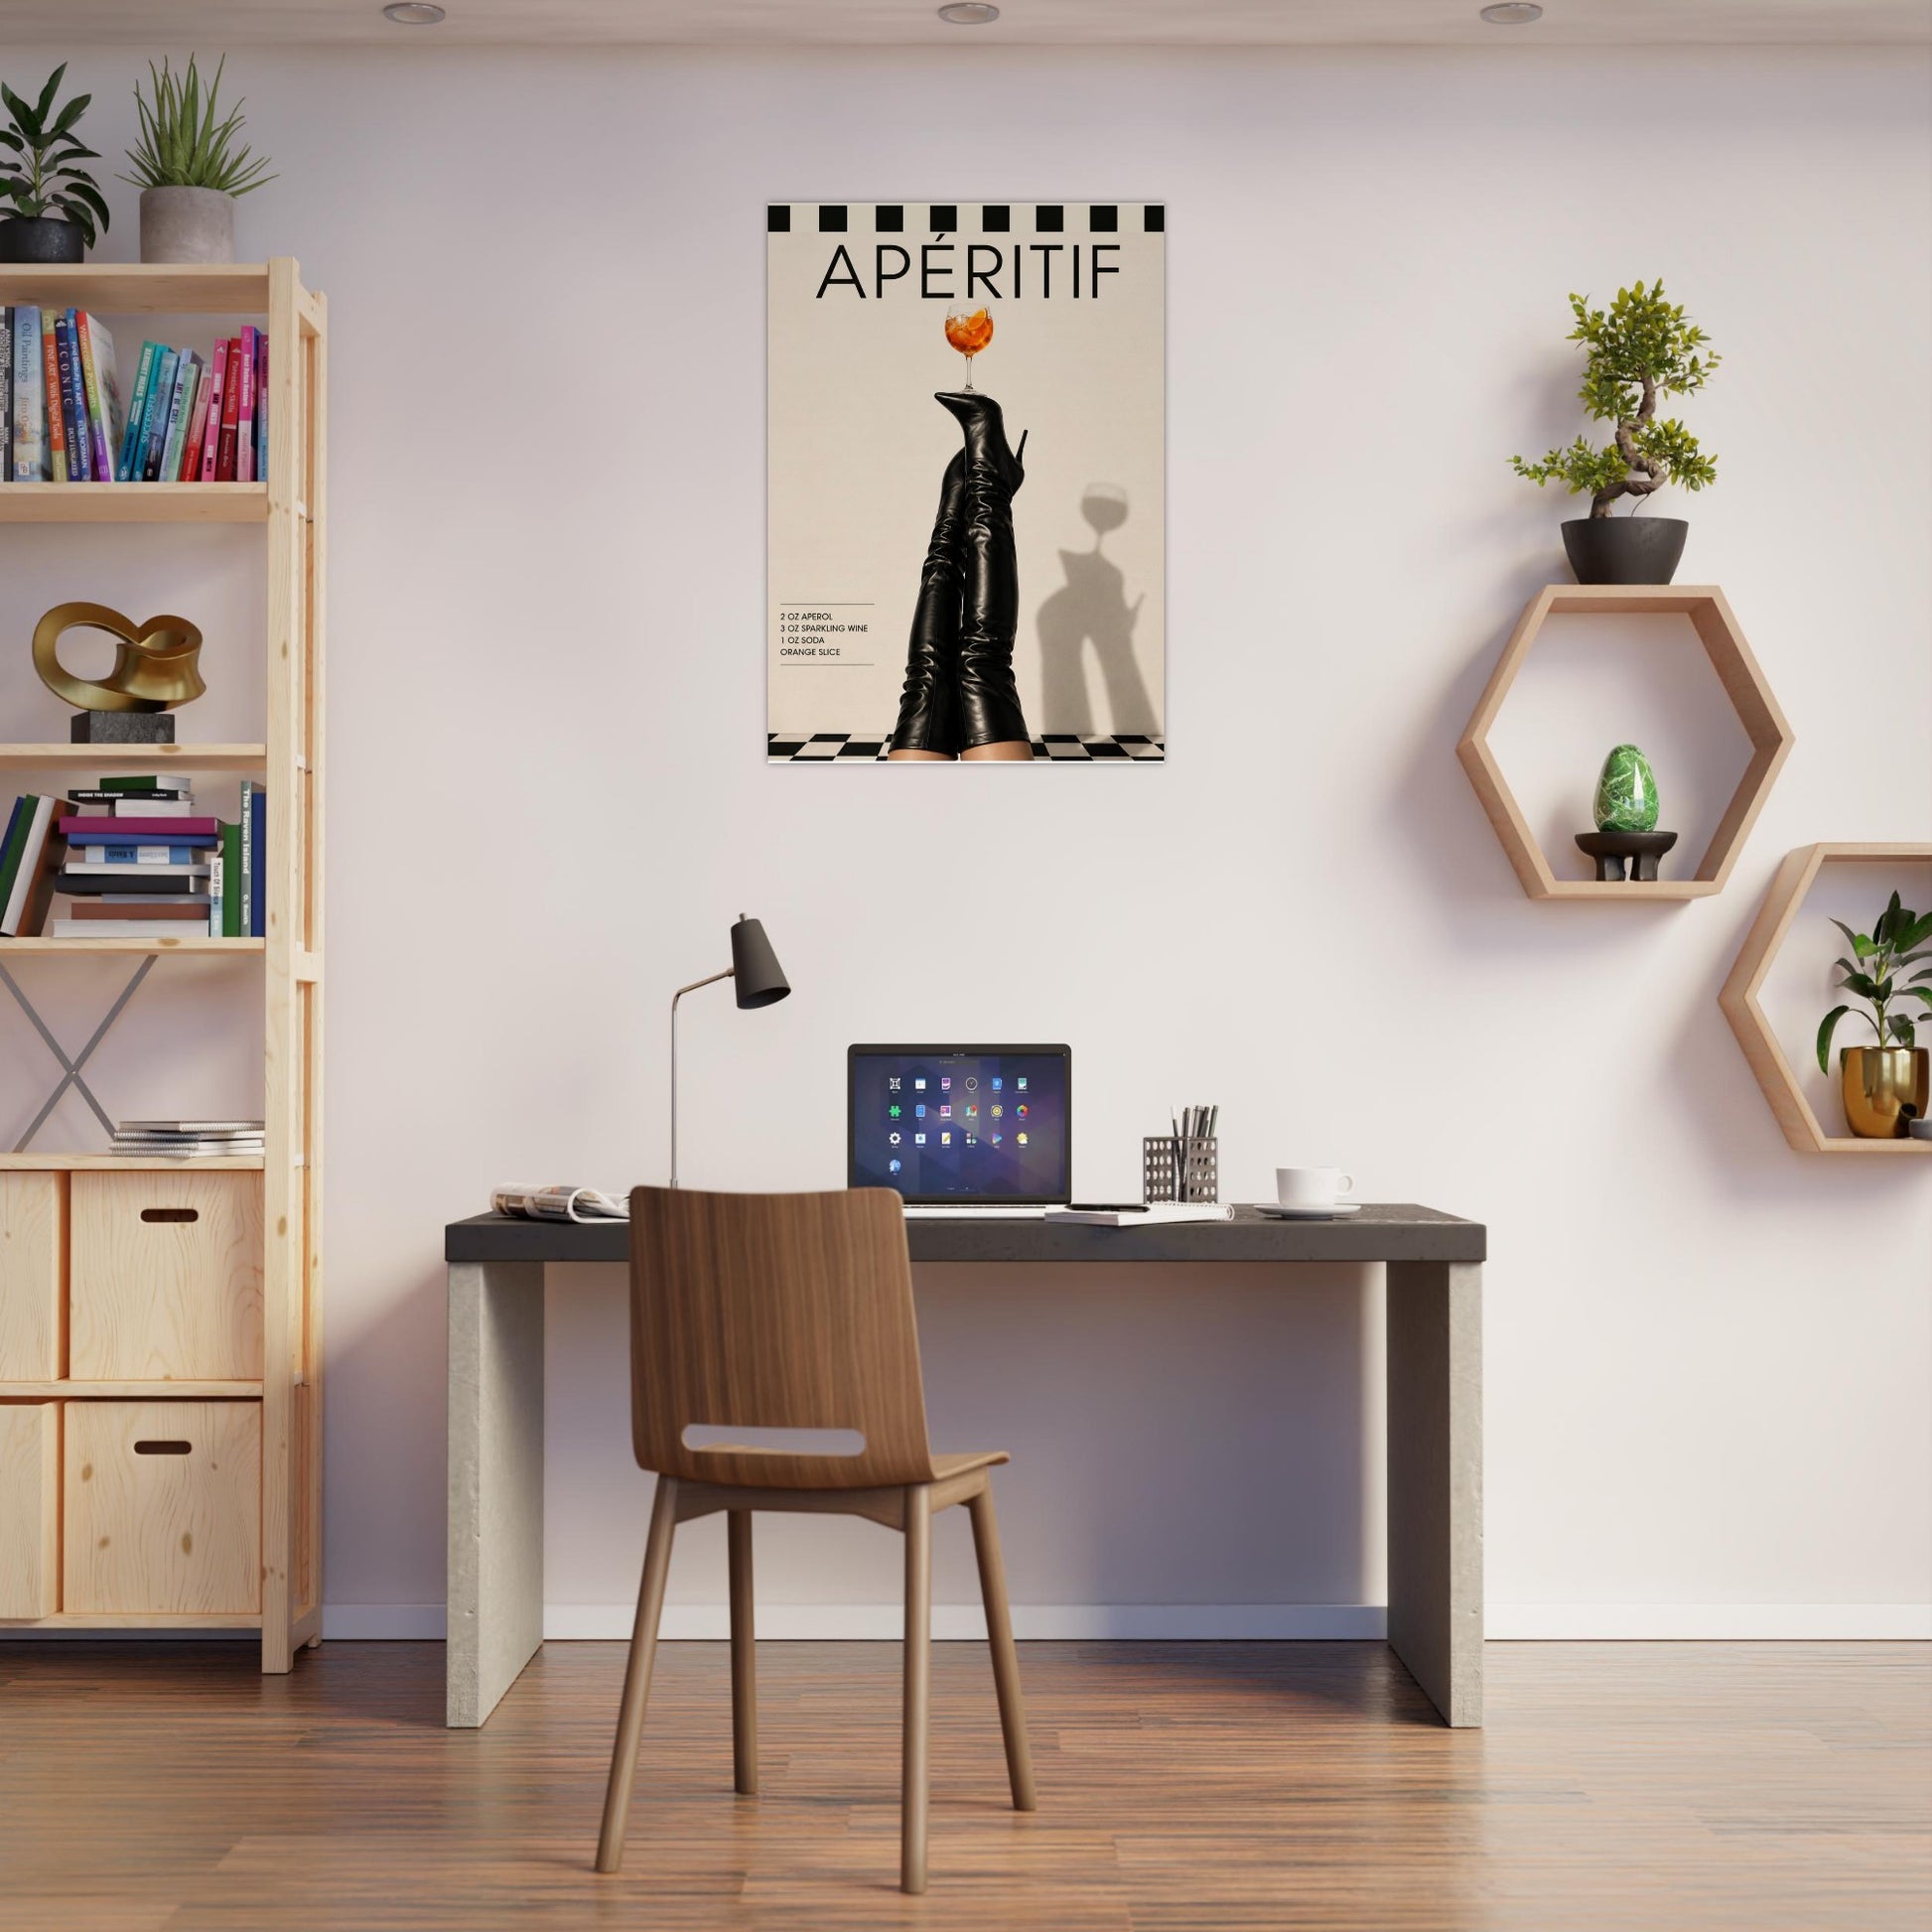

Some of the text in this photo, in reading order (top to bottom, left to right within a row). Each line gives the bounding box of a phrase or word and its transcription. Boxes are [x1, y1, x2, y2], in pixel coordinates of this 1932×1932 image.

[815, 233, 1121, 299] APÉRITIF
[18, 323, 32, 383] Oil Paintings
[59, 343, 72, 405] ICONIC
[78, 325, 97, 409] Watercolor Portraits
[141, 393, 157, 444] SUCCESSFUL
